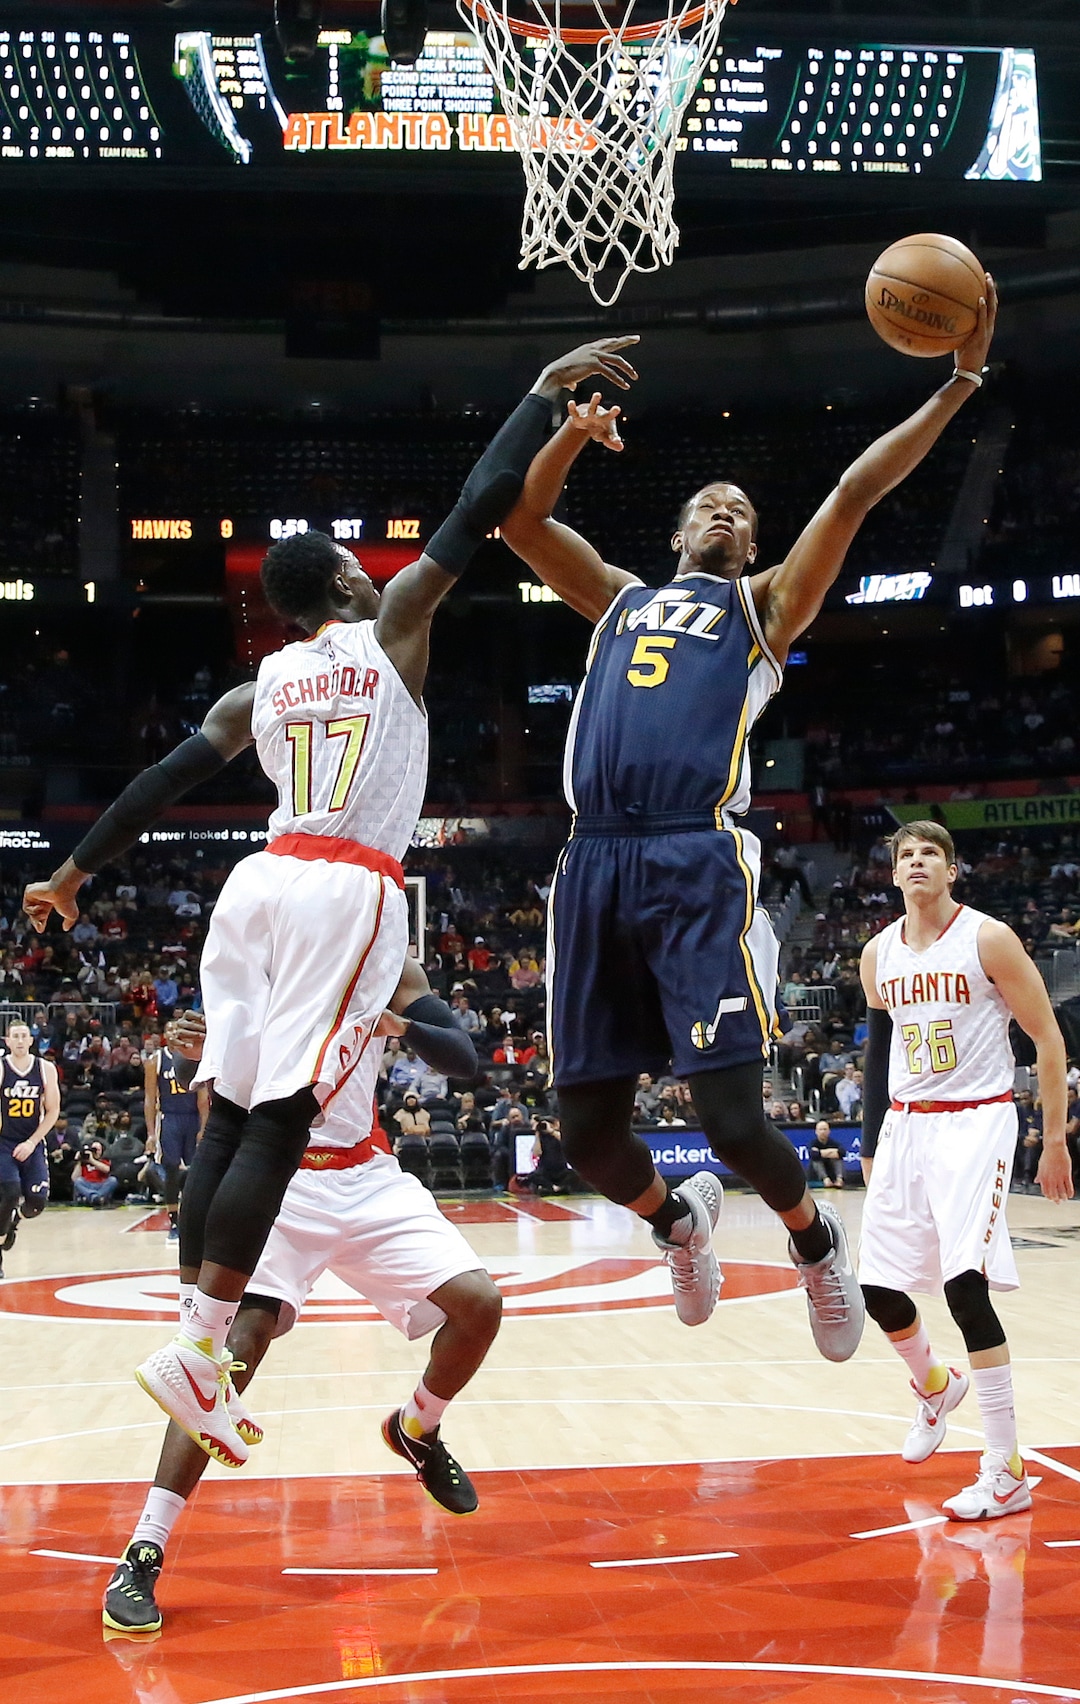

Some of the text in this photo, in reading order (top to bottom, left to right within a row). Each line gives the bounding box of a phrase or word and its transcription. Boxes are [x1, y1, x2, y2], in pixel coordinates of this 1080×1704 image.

[212, 36, 256, 48] TEAM STATS
[96, 46, 102, 58] 1
[425, 46, 437, 59] IN
[437, 46, 455, 59] THE
[5, 65, 13, 78] 2
[30, 66, 36, 78] 1
[54, 66, 60, 79] 1
[415, 59, 447, 72] BREAK
[448, 60, 483, 72] POINTS
[380, 72, 494, 87] SECOND CHANCE POINTS
[36, 86, 42, 98] 1
[381, 85, 494, 99] POINTS OFF TURNOVERS
[831, 82, 840, 95] 2
[898, 85, 905, 97] 1
[920, 85, 926, 98] 1
[259, 96, 265, 109] 1
[383, 98, 493, 112] THREE POINT SHOOTING
[696, 98, 711, 112] 20
[827, 101, 833, 114] 1
[849, 102, 855, 115] 1
[46, 107, 52, 119] 1
[3, 127, 11, 139] 2
[31, 127, 39, 140] 2
[284, 112, 453, 151] ATLANTA
[841, 122, 848, 135] 1
[83, 147, 89, 158] 1
[99, 147, 120, 158] TEAM
[155, 148, 161, 158] 1
[851, 161, 857, 172] 1
[863, 162, 883, 172] TEAM
[914, 163, 921, 174] 1
[878, 287, 957, 333] SPALDING
[131, 519, 233, 540] HAWKS 9
[331, 518, 363, 540] 1ST
[386, 519, 420, 540] JAZZ
[84, 581, 95, 603] 1
[1012, 580, 1027, 602] 0
[626, 635, 677, 689] 5
[285, 713, 370, 817] 17
[152, 830, 185, 841] never
[189, 829, 229, 841] looked
[231, 830, 248, 841] so
[881, 972, 971, 1010] ATLANTA
[900, 1019, 957, 1075] 26
[8, 1098, 36, 1118] 20
[984, 1159, 1007, 1245] HAWKS
